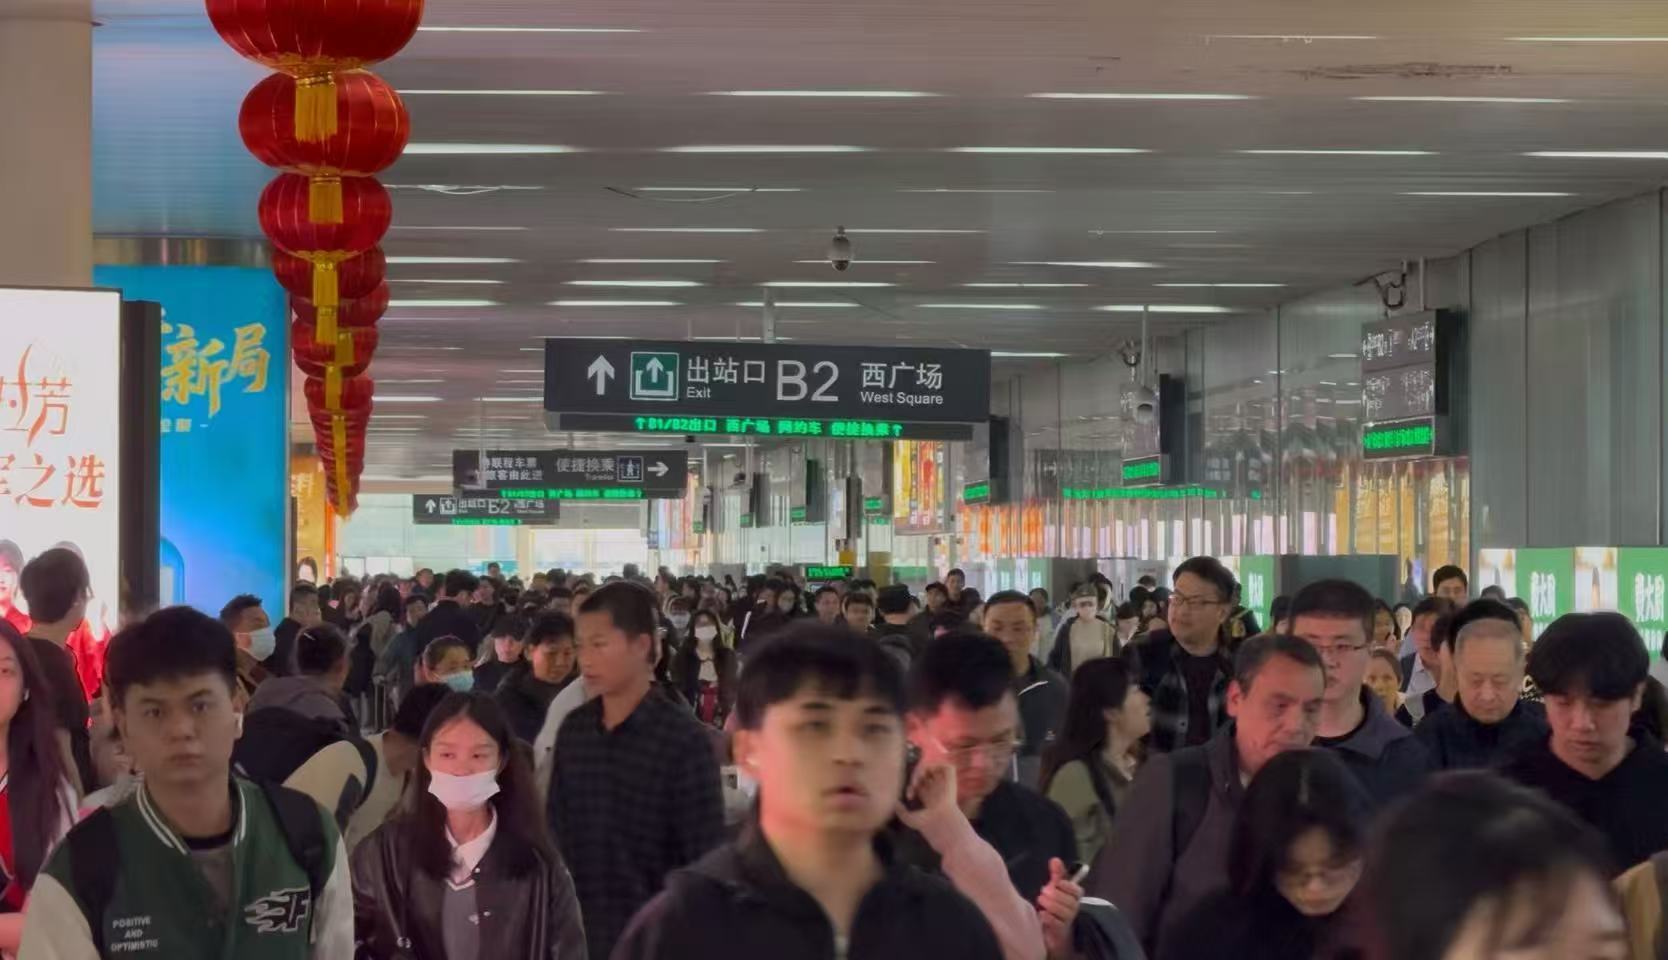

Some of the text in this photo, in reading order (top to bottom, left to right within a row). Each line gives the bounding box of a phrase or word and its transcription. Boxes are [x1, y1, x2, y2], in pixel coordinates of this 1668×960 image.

[687, 356, 766, 384] 出站口
[860, 362, 943, 390] 西广场
[776, 360, 839, 402] B2
[686, 387, 711, 398] Exit
[861, 391, 943, 406] West Square
[112, 915, 151, 928] POSITIVE
[124, 929, 143, 938] AND
